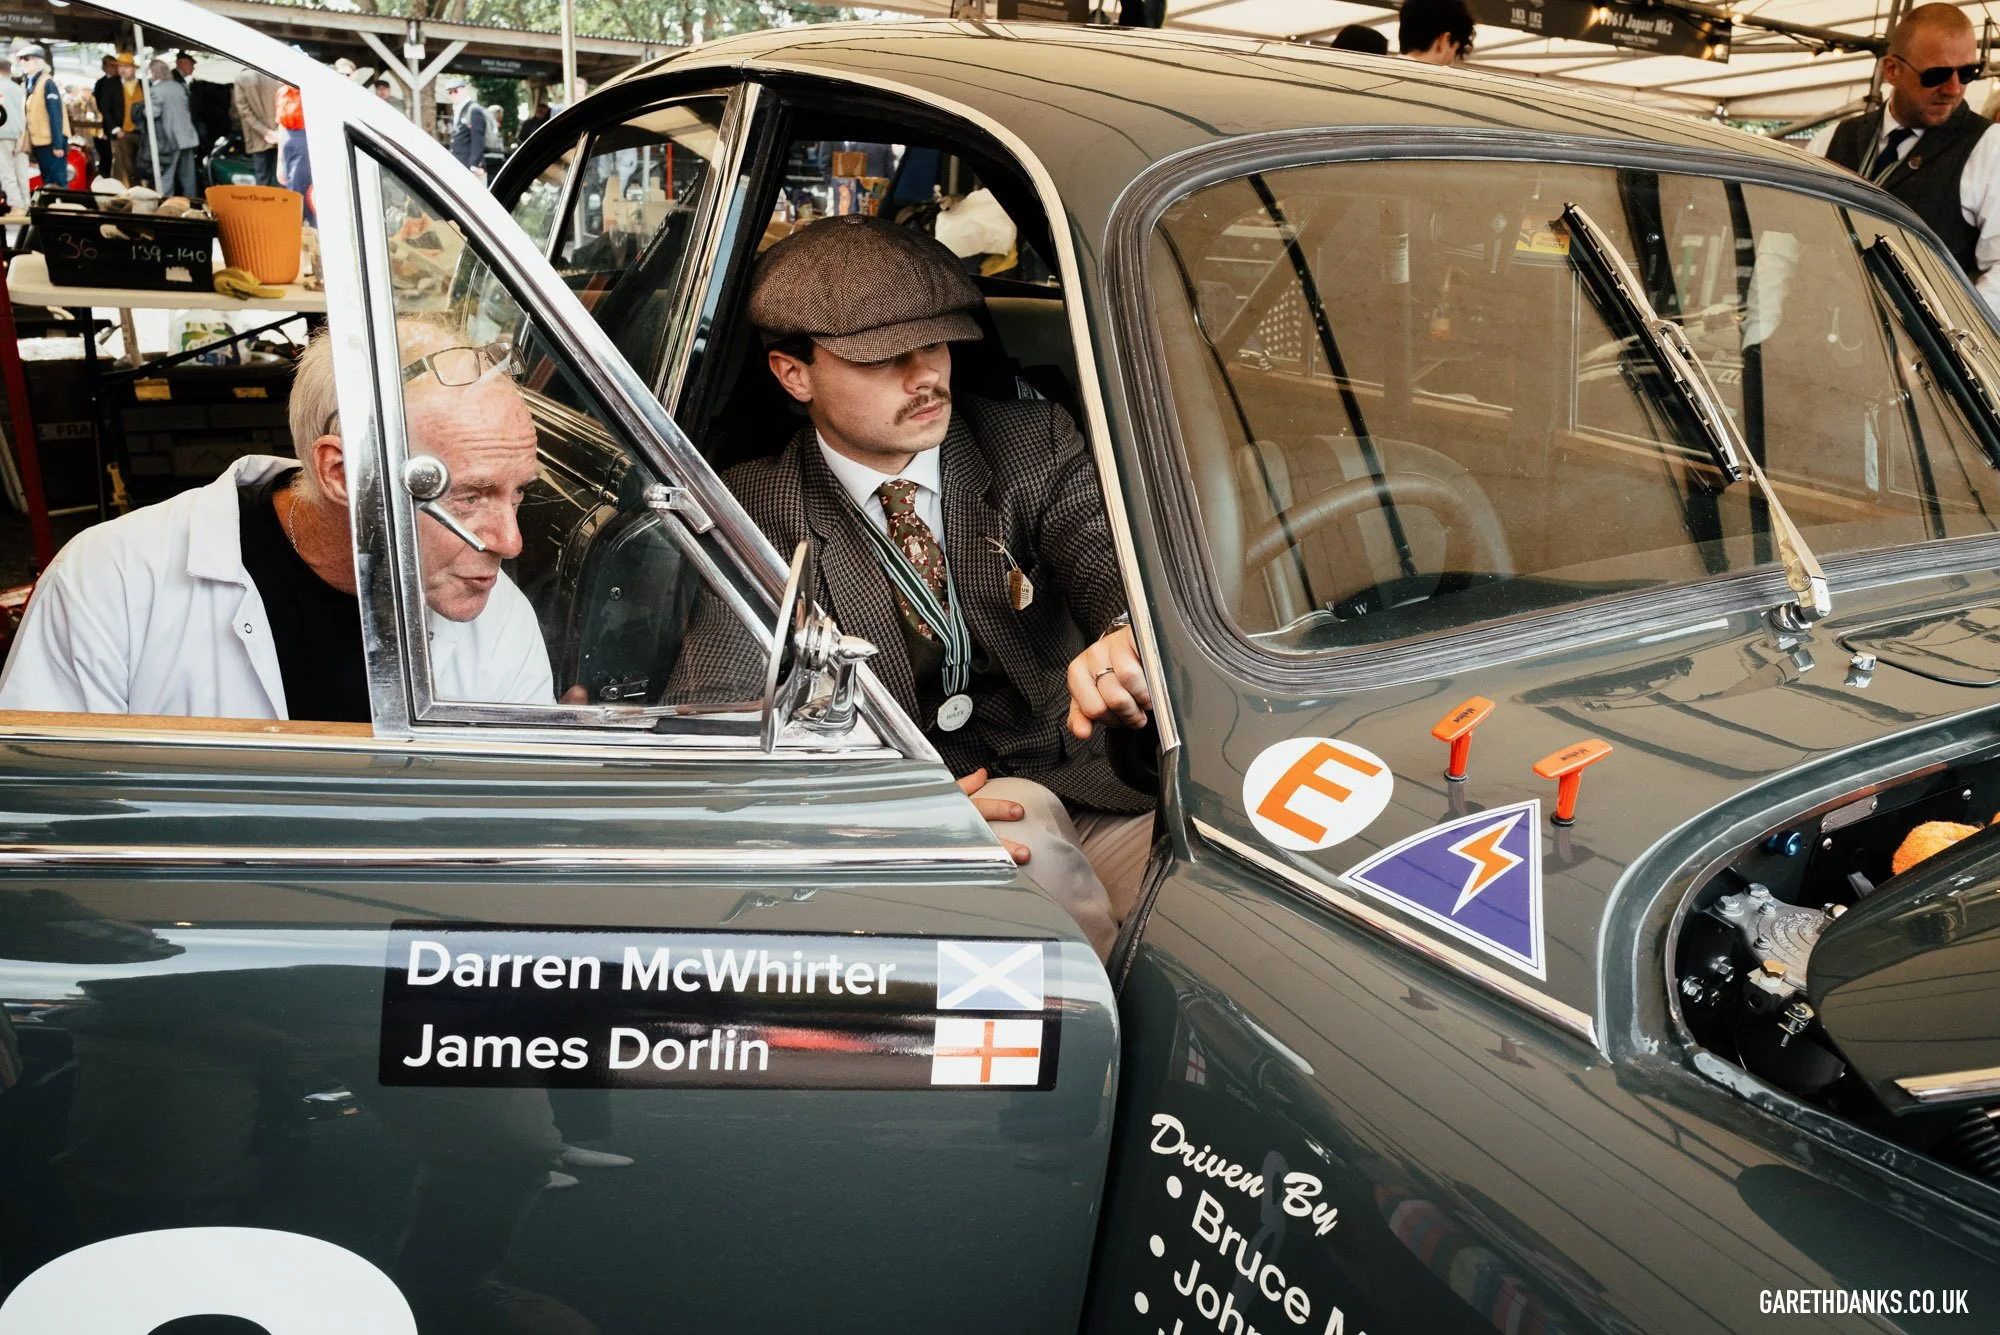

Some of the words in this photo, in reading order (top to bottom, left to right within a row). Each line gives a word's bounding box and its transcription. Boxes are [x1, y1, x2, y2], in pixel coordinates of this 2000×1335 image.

[1625, 14, 1655, 34] Jaguar
[1655, 19, 1673, 36] Mk2
[57, 232, 98, 260] 36
[1355, 602, 1368, 616] W
[1256, 741, 1383, 844] E
[407, 941, 600, 989] Darren
[622, 947, 895, 995] McWhirter
[403, 1024, 588, 1069] James
[609, 1027, 769, 1071] Dorlin
[1150, 1113, 1265, 1198] Driven
[1282, 1171, 1338, 1237] By
[1191, 1189, 1311, 1325] Bruce
